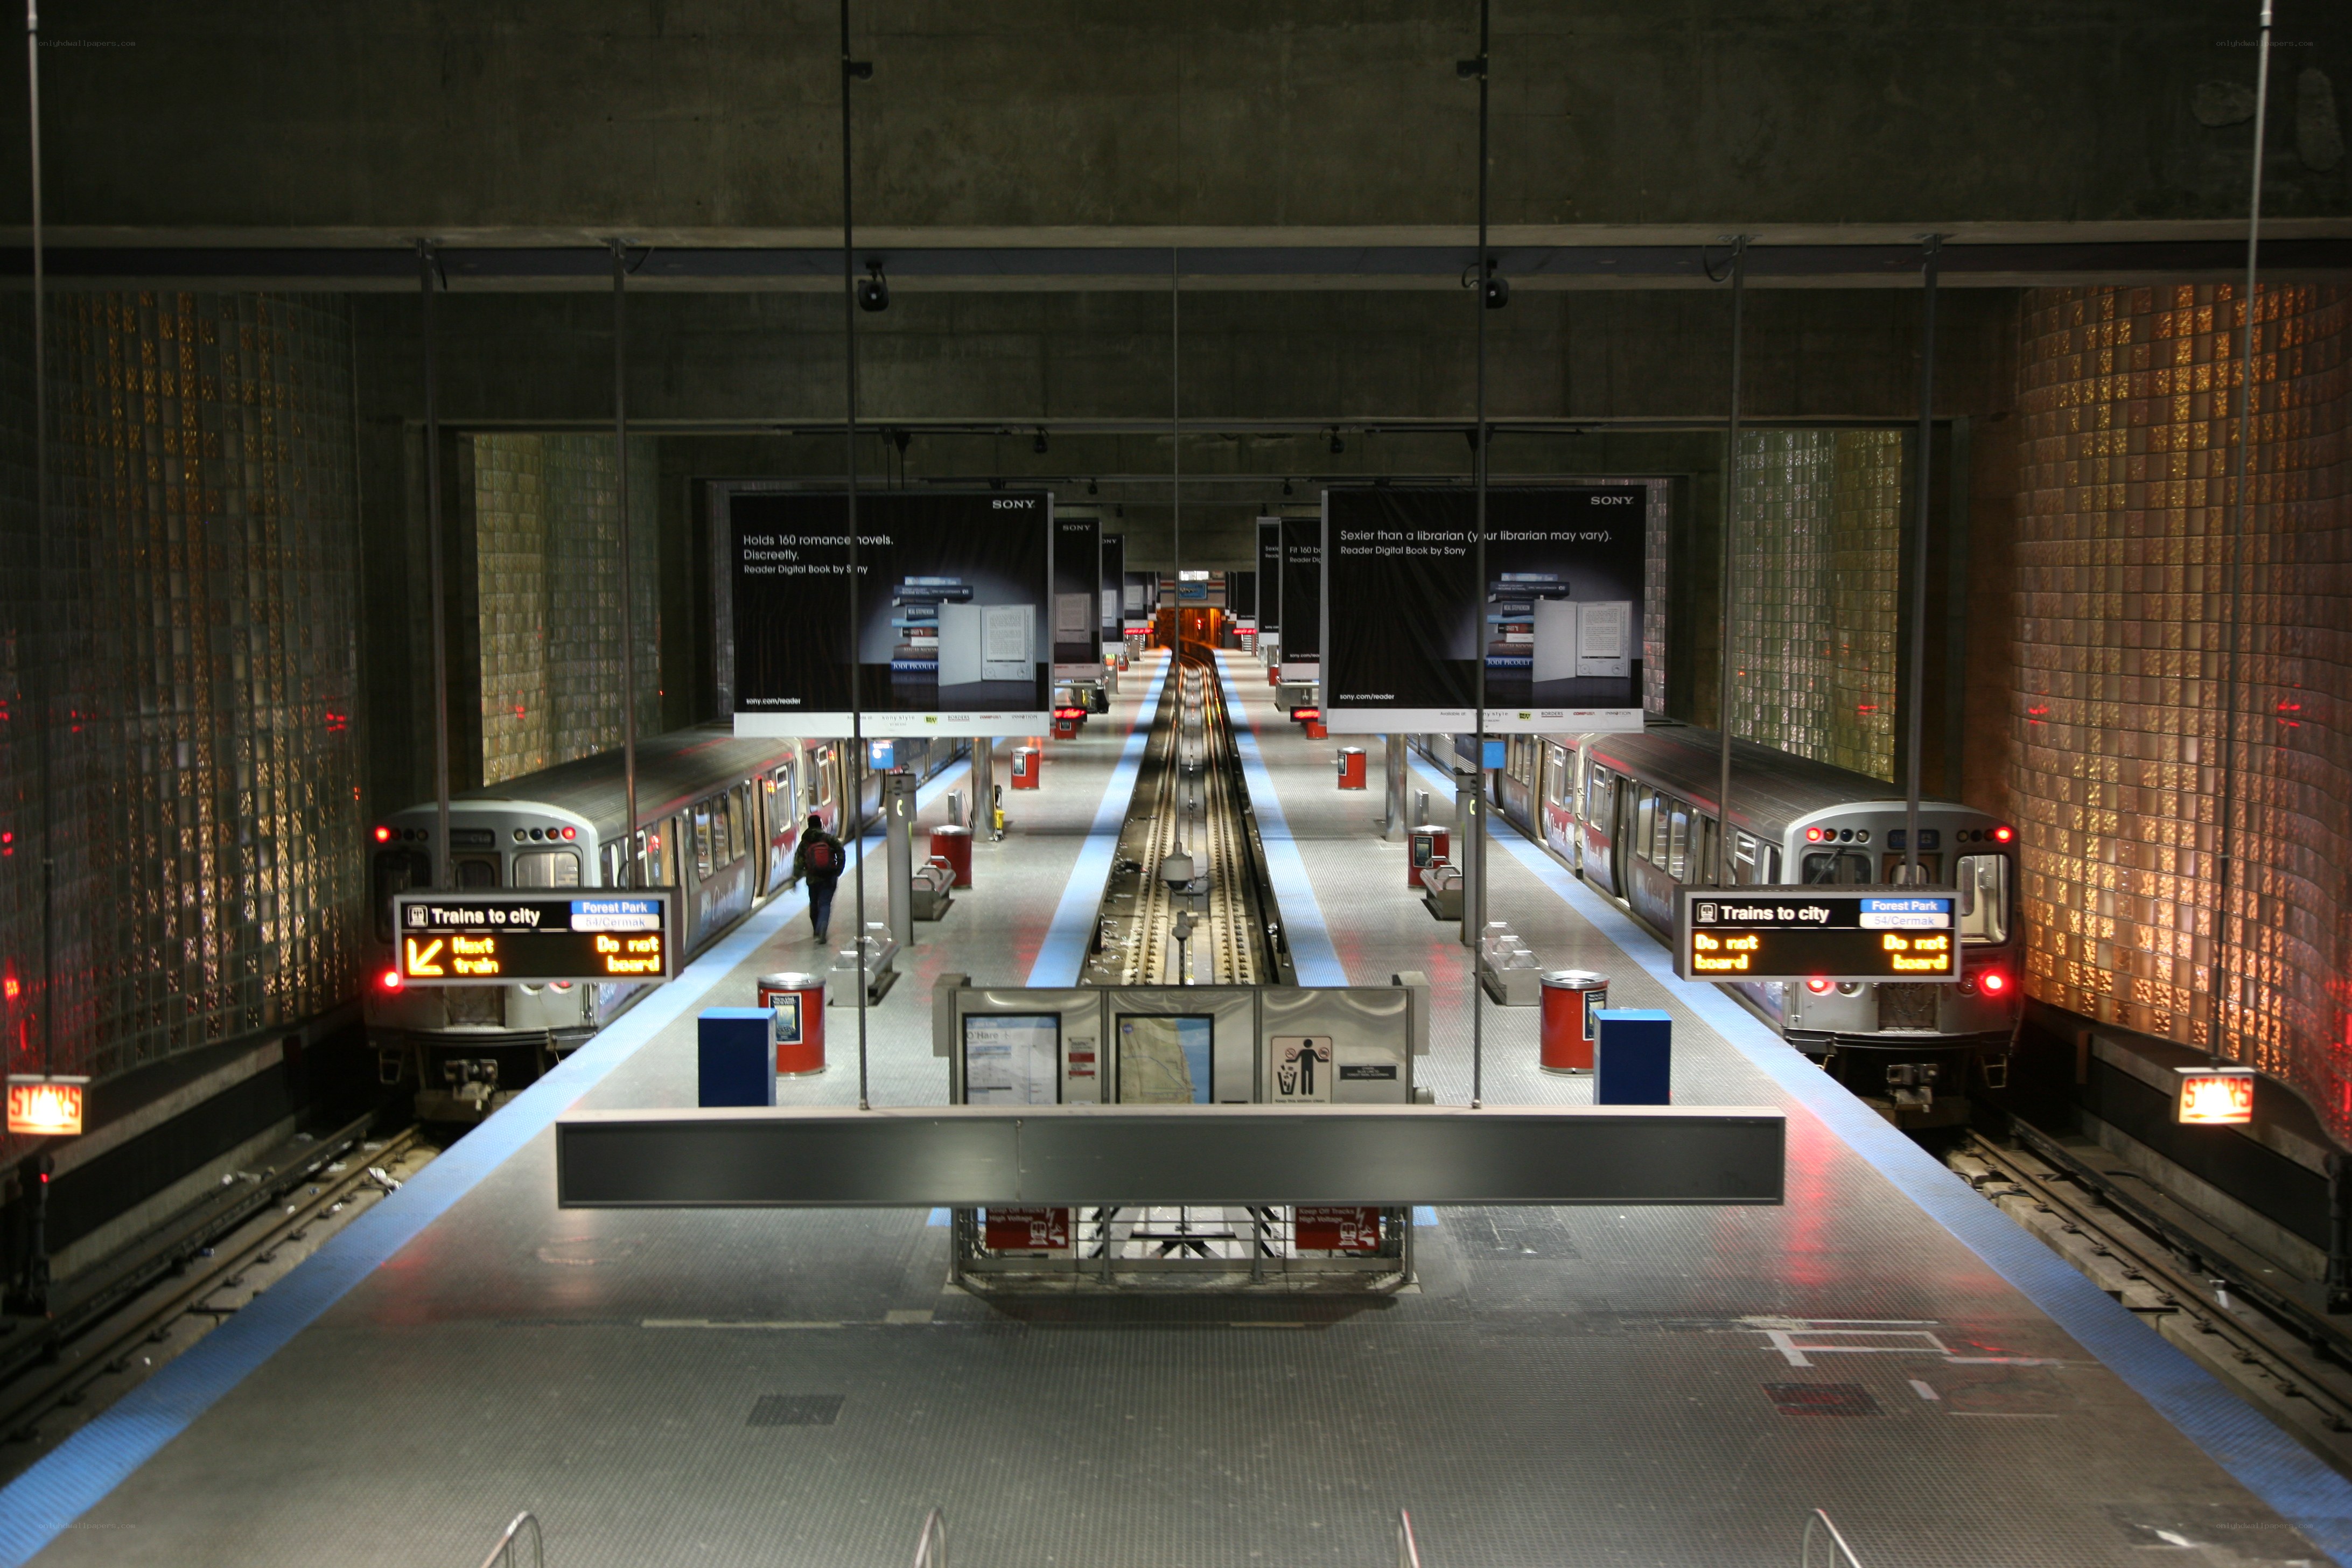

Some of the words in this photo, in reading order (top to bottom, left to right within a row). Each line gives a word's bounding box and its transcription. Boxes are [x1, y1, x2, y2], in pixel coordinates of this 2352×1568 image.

[992, 500, 1035, 509] SONY
[1591, 496, 1634, 505] SONY
[744, 534, 775, 545] Holds
[779, 534, 796, 545] 160
[799, 536, 851, 545] romance
[1340, 530, 1374, 541] Sexier
[1377, 530, 1402, 541] than
[1406, 532, 1413, 541] a
[1417, 530, 1464, 541] librarian
[1500, 530, 1547, 541] librarian
[1550, 531, 1576, 542] may
[1579, 530, 1612, 543] vary).
[744, 549, 799, 562] Discreetly.
[1340, 547, 1374, 555] Reader
[1375, 546, 1404, 556] Digital
[1406, 547, 1428, 555] Book
[1430, 546, 1442, 556] by
[1444, 547, 1466, 556] Sony
[744, 564, 776, 574] Reader
[778, 564, 806, 576] Digital
[808, 564, 831, 574] Book
[833, 564, 845, 575] by
[846, 564, 869, 575] Sny
[746, 697, 801, 706] sony.com/reader
[583, 902, 619, 913] Forest
[622, 902, 648, 913] Park
[1872, 901, 1909, 911] Forest
[1912, 901, 1938, 911] Park
[431, 908, 485, 925] Trains
[488, 908, 506, 925] to
[510, 908, 540, 927] city
[1720, 905, 1774, 921] Trains
[1777, 906, 1795, 921] to
[1797, 905, 1830, 924] city
[586, 916, 646, 928] 54/Cermak
[1873, 916, 1935, 927] 54/Cermak
[452, 936, 495, 954] Next
[596, 935, 620, 953] Do
[628, 936, 659, 953] not
[1695, 934, 1719, 950] Do
[1725, 935, 1759, 950] not
[1883, 934, 1908, 950] Do
[1914, 935, 1948, 950] not
[453, 957, 499, 974] train
[607, 954, 660, 972] board
[1695, 954, 1748, 970] board
[1892, 954, 1948, 970] board
[967, 1031, 999, 1039] O'Hare
[989, 1215, 1006, 1223] High
[1299, 1215, 1315, 1223] High
[1317, 1215, 1343, 1223] Voltage
